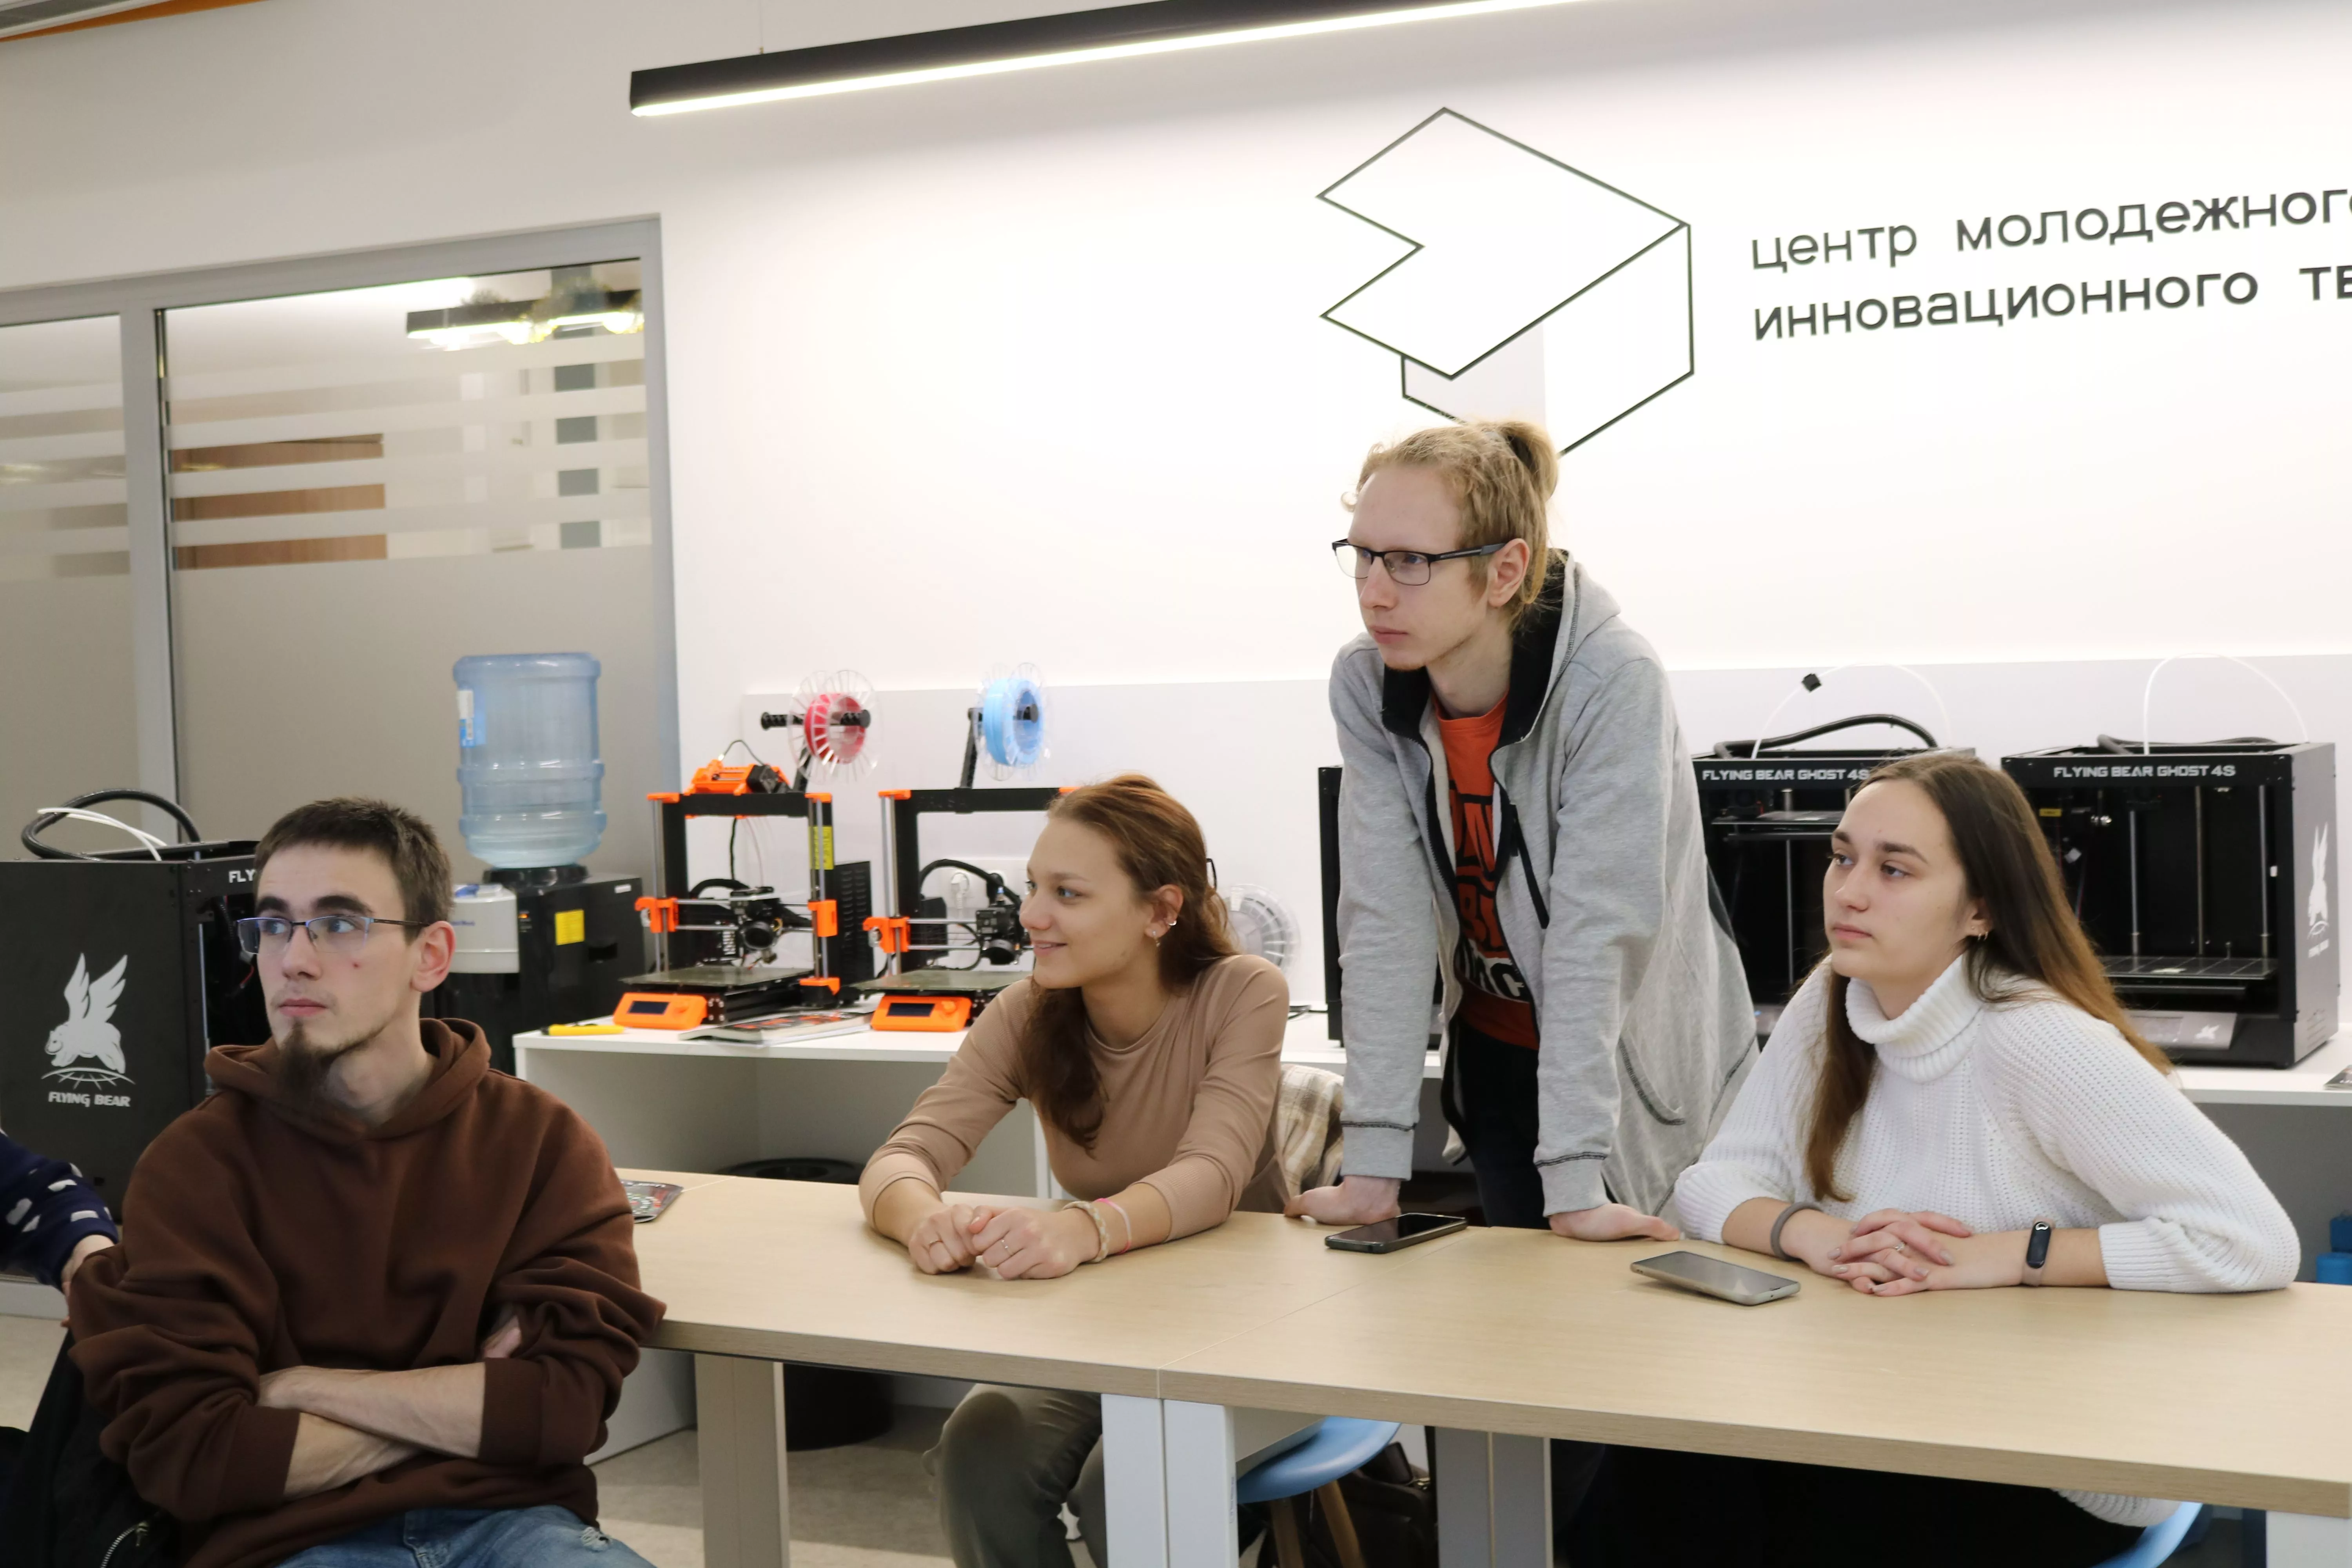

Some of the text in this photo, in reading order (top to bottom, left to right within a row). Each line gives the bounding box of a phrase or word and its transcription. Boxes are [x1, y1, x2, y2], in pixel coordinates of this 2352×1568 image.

[1752, 189, 2352, 273] центр молодежног
[1755, 272, 2258, 341] инновационного
[1702, 768, 1870, 780] FLYING BEAR GHOST 4S
[2054, 765, 2236, 777] FLYING BEAR GHOST 4S
[228, 868, 256, 883] FLY
[48, 1091, 131, 1108] FLYING BEAR
